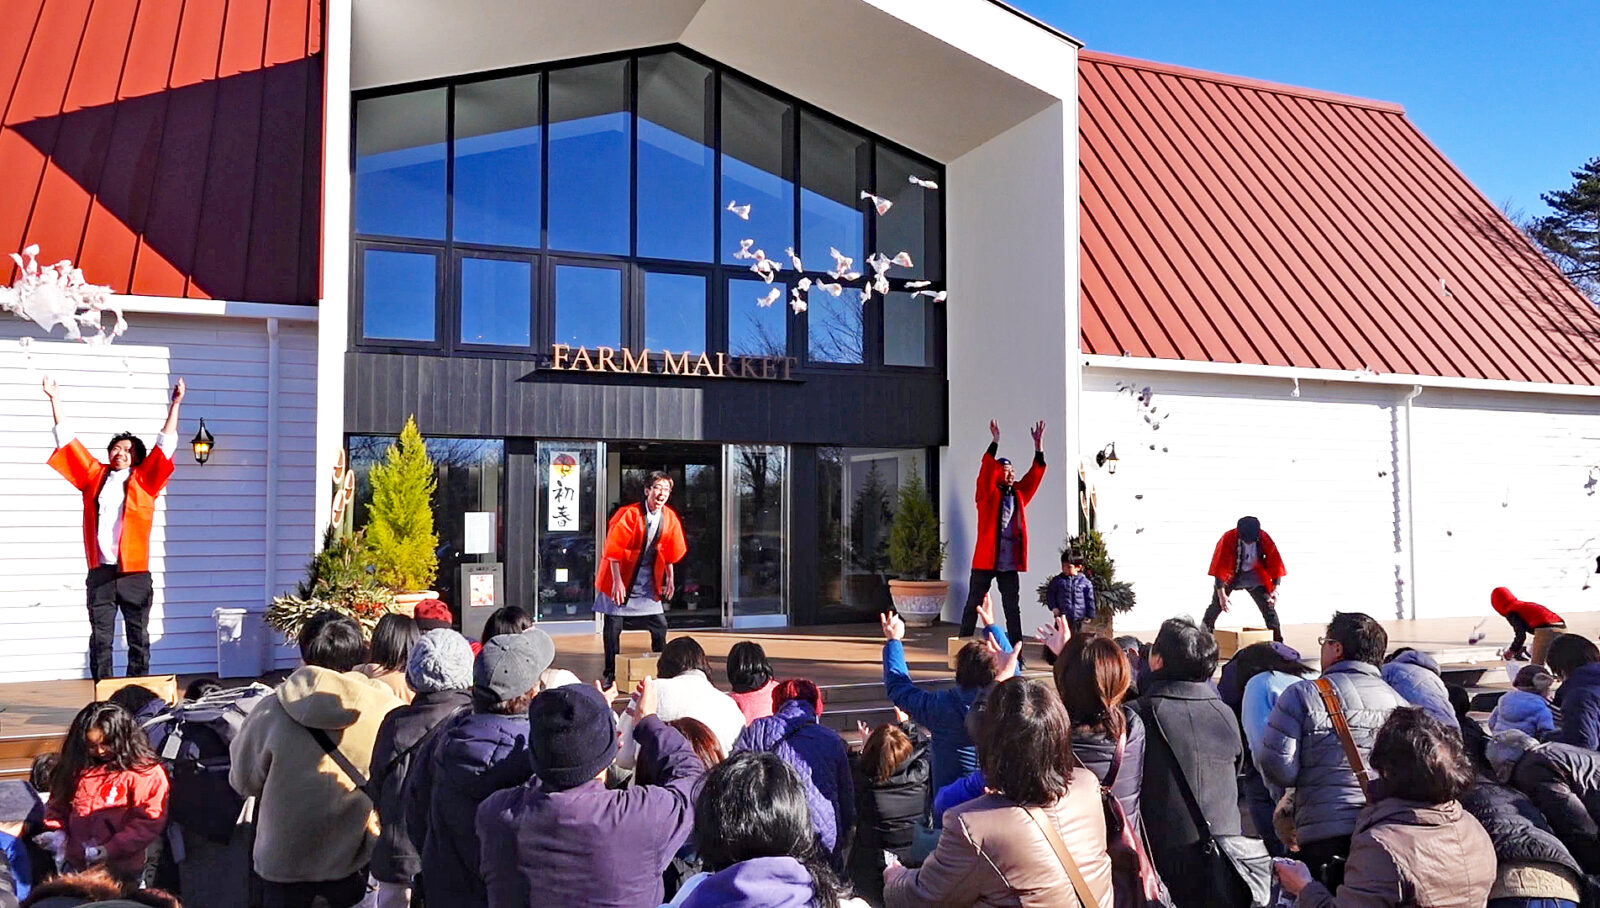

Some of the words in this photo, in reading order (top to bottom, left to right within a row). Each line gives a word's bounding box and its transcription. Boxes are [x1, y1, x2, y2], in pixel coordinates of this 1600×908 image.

[551, 343, 650, 373] FARM
[663, 349, 798, 380] MARKET
[552, 480, 575, 528] 初春
